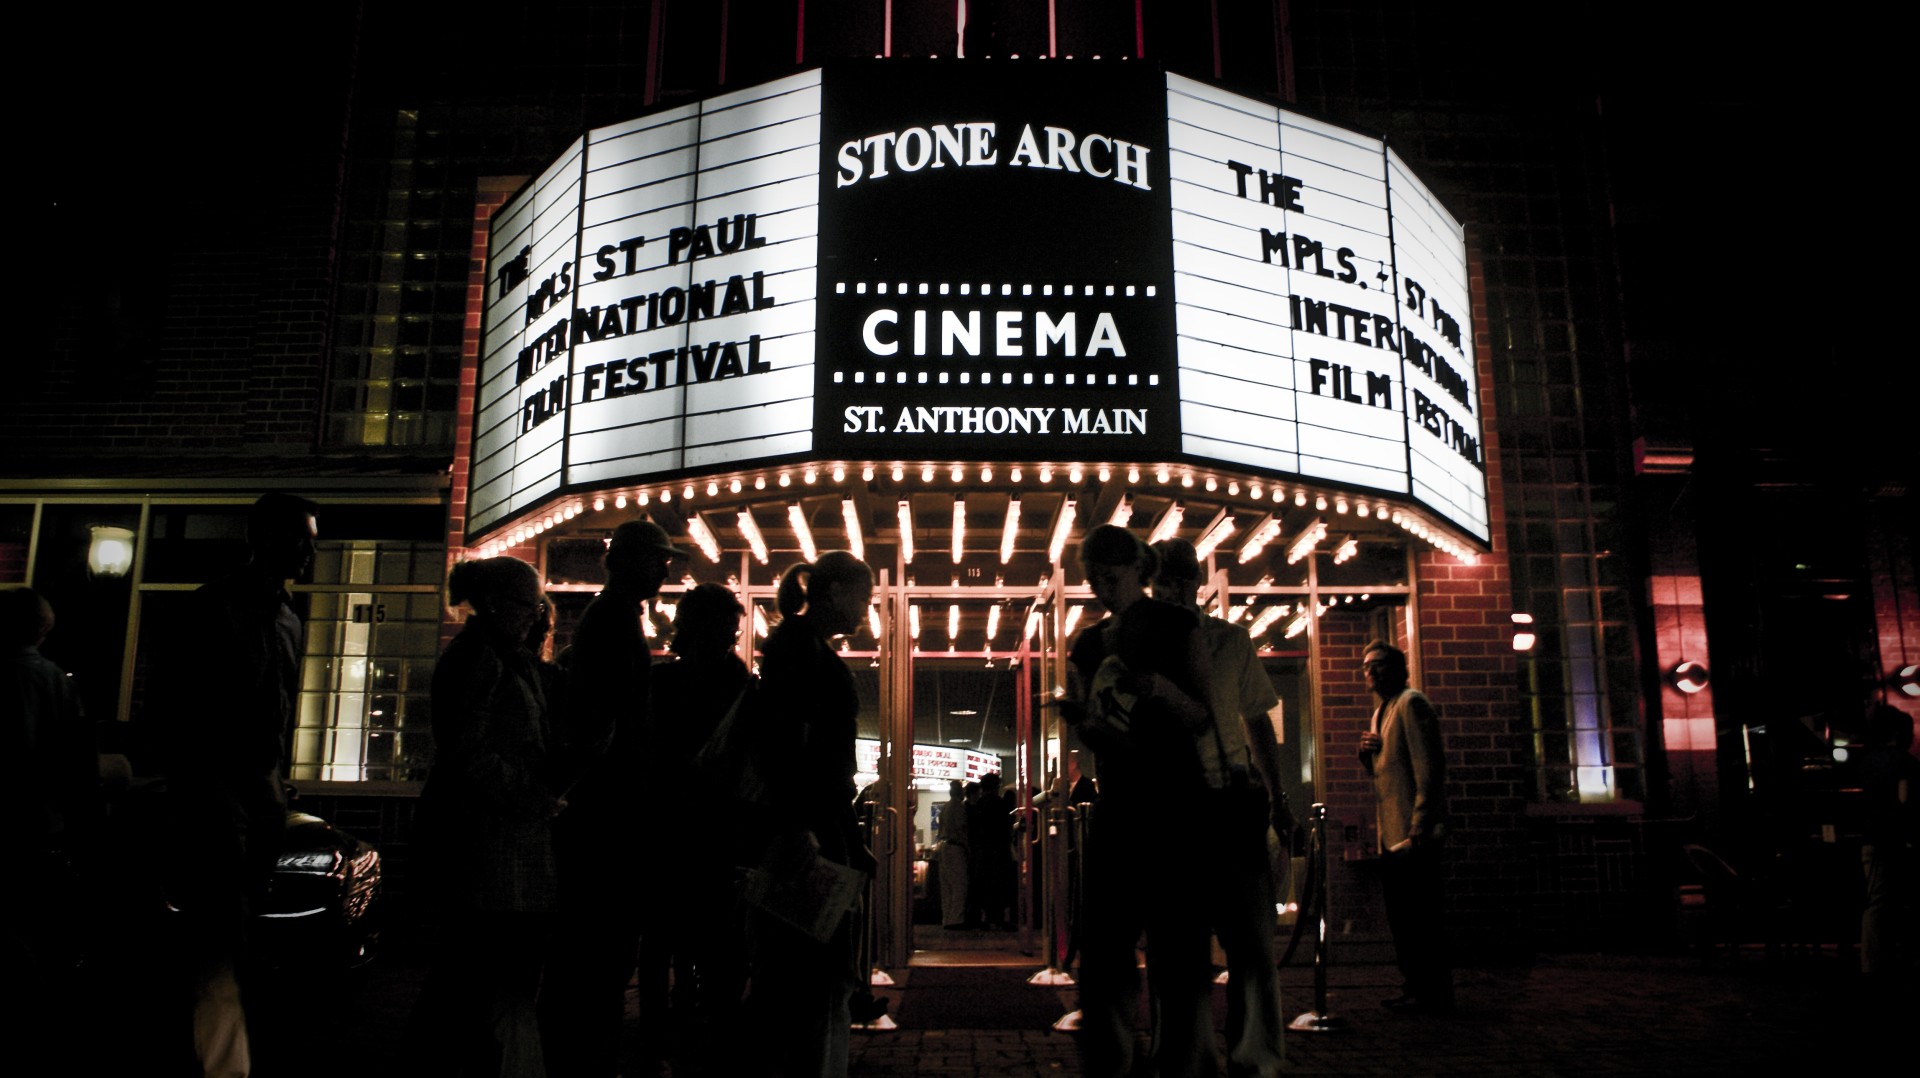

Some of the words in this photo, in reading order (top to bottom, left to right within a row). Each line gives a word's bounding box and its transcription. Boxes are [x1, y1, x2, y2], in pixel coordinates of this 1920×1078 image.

[837, 122, 998, 188] STONE
[1009, 123, 1152, 190] ARCH
[1228, 160, 1304, 214] THE
[593, 236, 644, 281] ST
[668, 214, 766, 265] PAUL
[1405, 277, 1424, 321] ST
[862, 309, 1127, 357] CINEMA
[522, 375, 565, 435] FILM
[582, 335, 771, 402] FESTIVAL
[1310, 359, 1391, 409] FILM
[843, 405, 885, 433] ST.
[893, 406, 1056, 434] ANTHONY
[1062, 408, 1148, 435] MAIN
[967, 568, 980, 577] 115
[355, 604, 385, 623] 115
